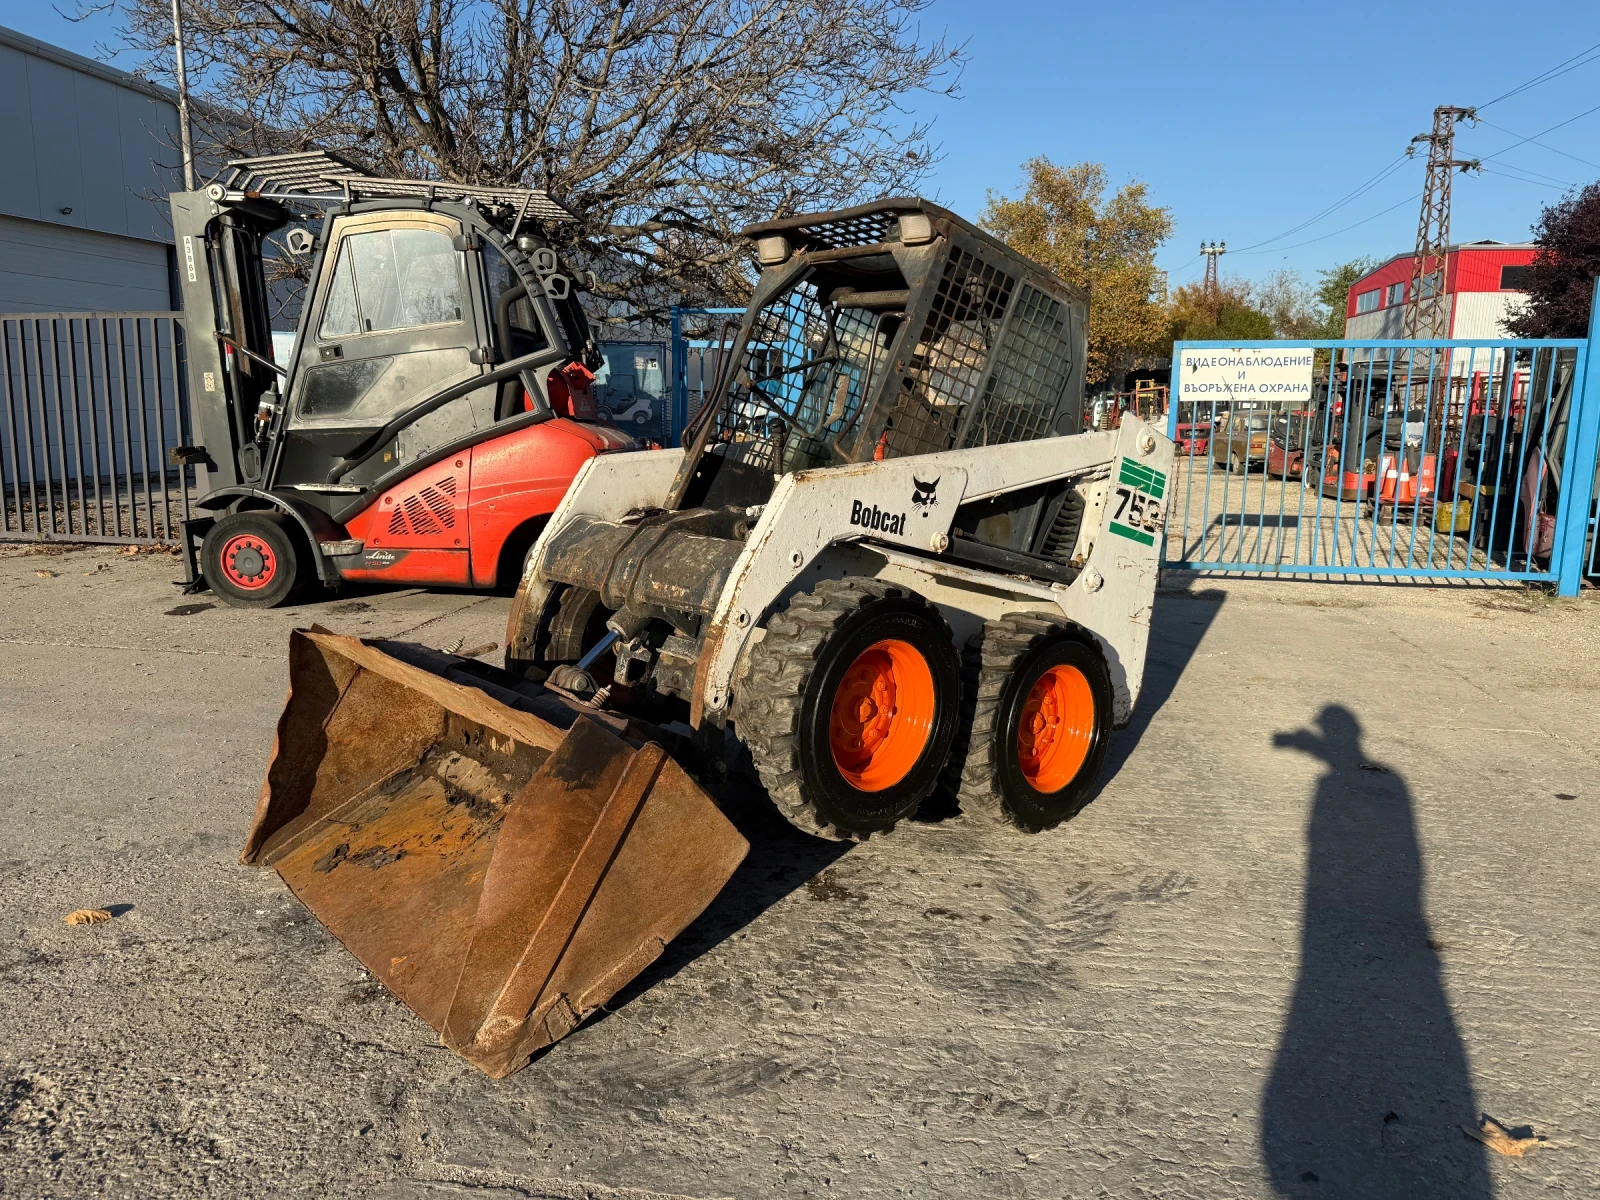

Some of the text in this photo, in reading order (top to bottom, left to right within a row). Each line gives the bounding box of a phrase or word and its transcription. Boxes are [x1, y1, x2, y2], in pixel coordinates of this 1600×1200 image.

[185, 237, 195, 280] A3969
[1186, 356, 1312, 368] ВИДЕОНАБЛЮДЕНИЕ
[1237, 370, 1246, 380] И
[1184, 383, 1309, 393] ВЪОРЪЖЕНА ОХРАНА
[850, 499, 906, 536] Bobcat
[365, 550, 395, 560] Linde
